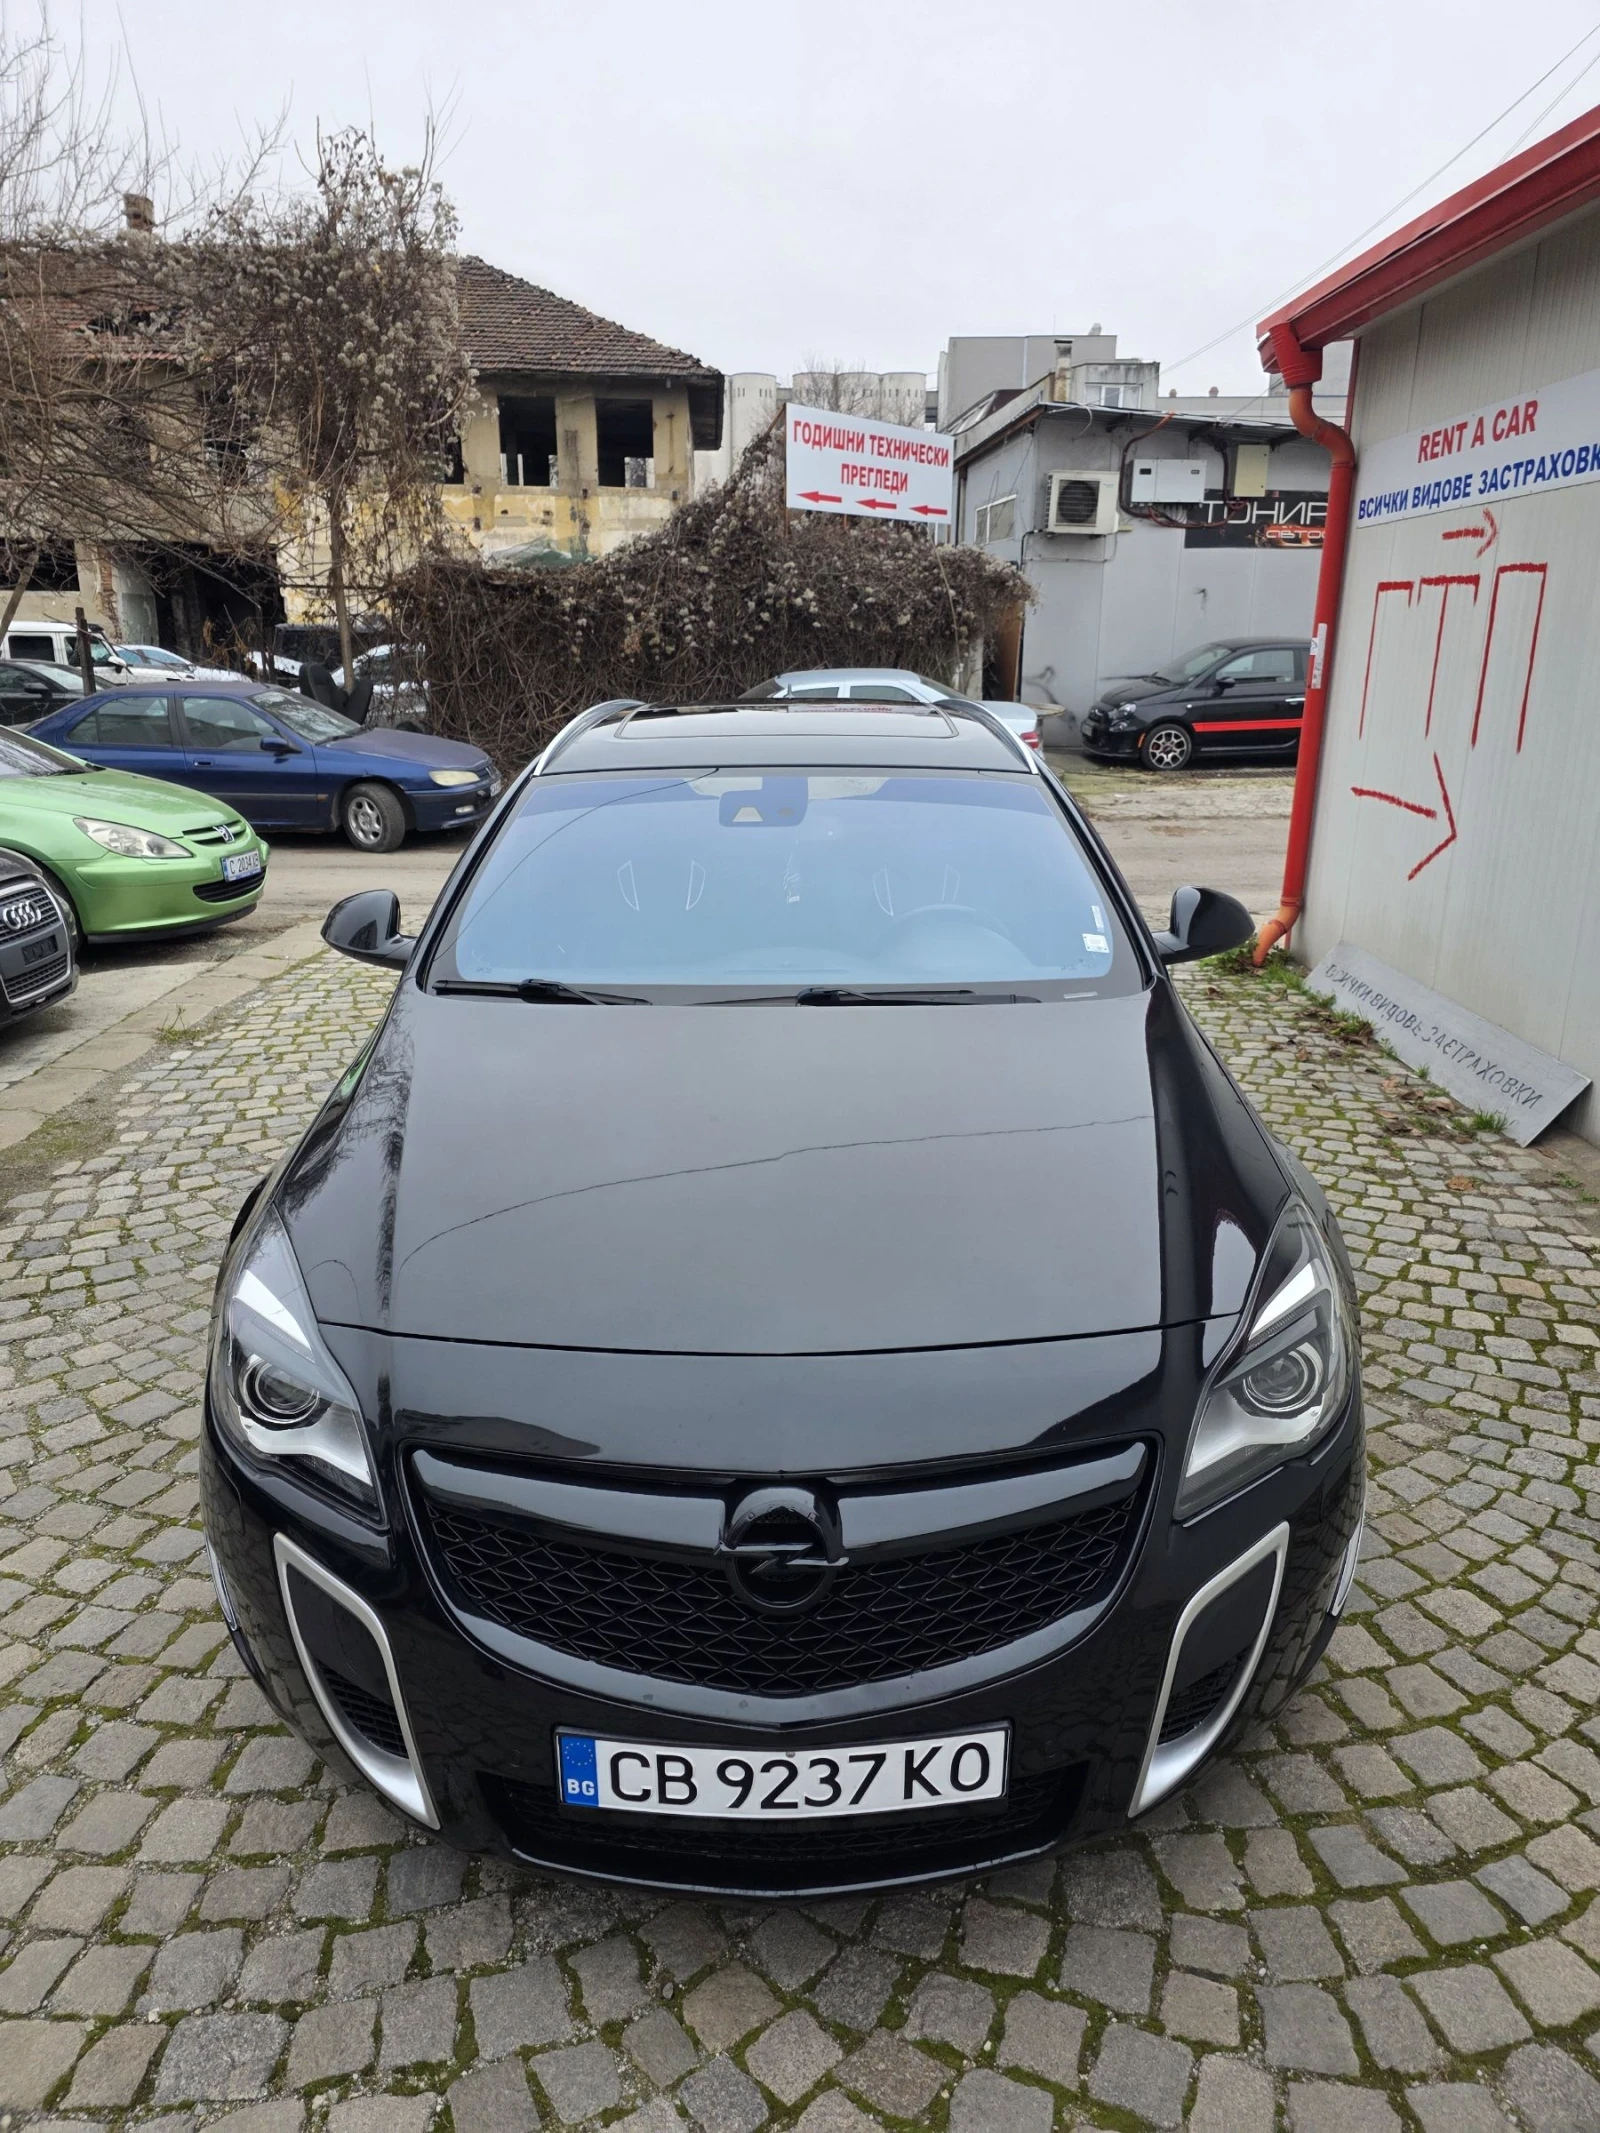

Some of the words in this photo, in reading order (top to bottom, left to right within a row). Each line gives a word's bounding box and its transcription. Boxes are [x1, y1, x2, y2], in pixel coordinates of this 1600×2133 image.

[793, 419, 865, 454] ГОДИШНИ
[869, 434, 949, 468] ТЕХНИЧЕСКИ
[1417, 421, 1468, 464] RENT
[1470, 416, 1485, 449] A
[1492, 399, 1539, 442] CAR
[841, 463, 909, 495] ПРЕГЛЕДИ
[1358, 488, 1409, 520] ВСИЧКИ
[1411, 474, 1473, 510] ВИДОВЕ
[1370, 993, 1422, 1036] ВИДОВЕ
[567, 1778, 596, 1797] BG
[609, 1750, 698, 1805] CB
[715, 1752, 887, 1810] 9237
[902, 1741, 991, 1801] KO
